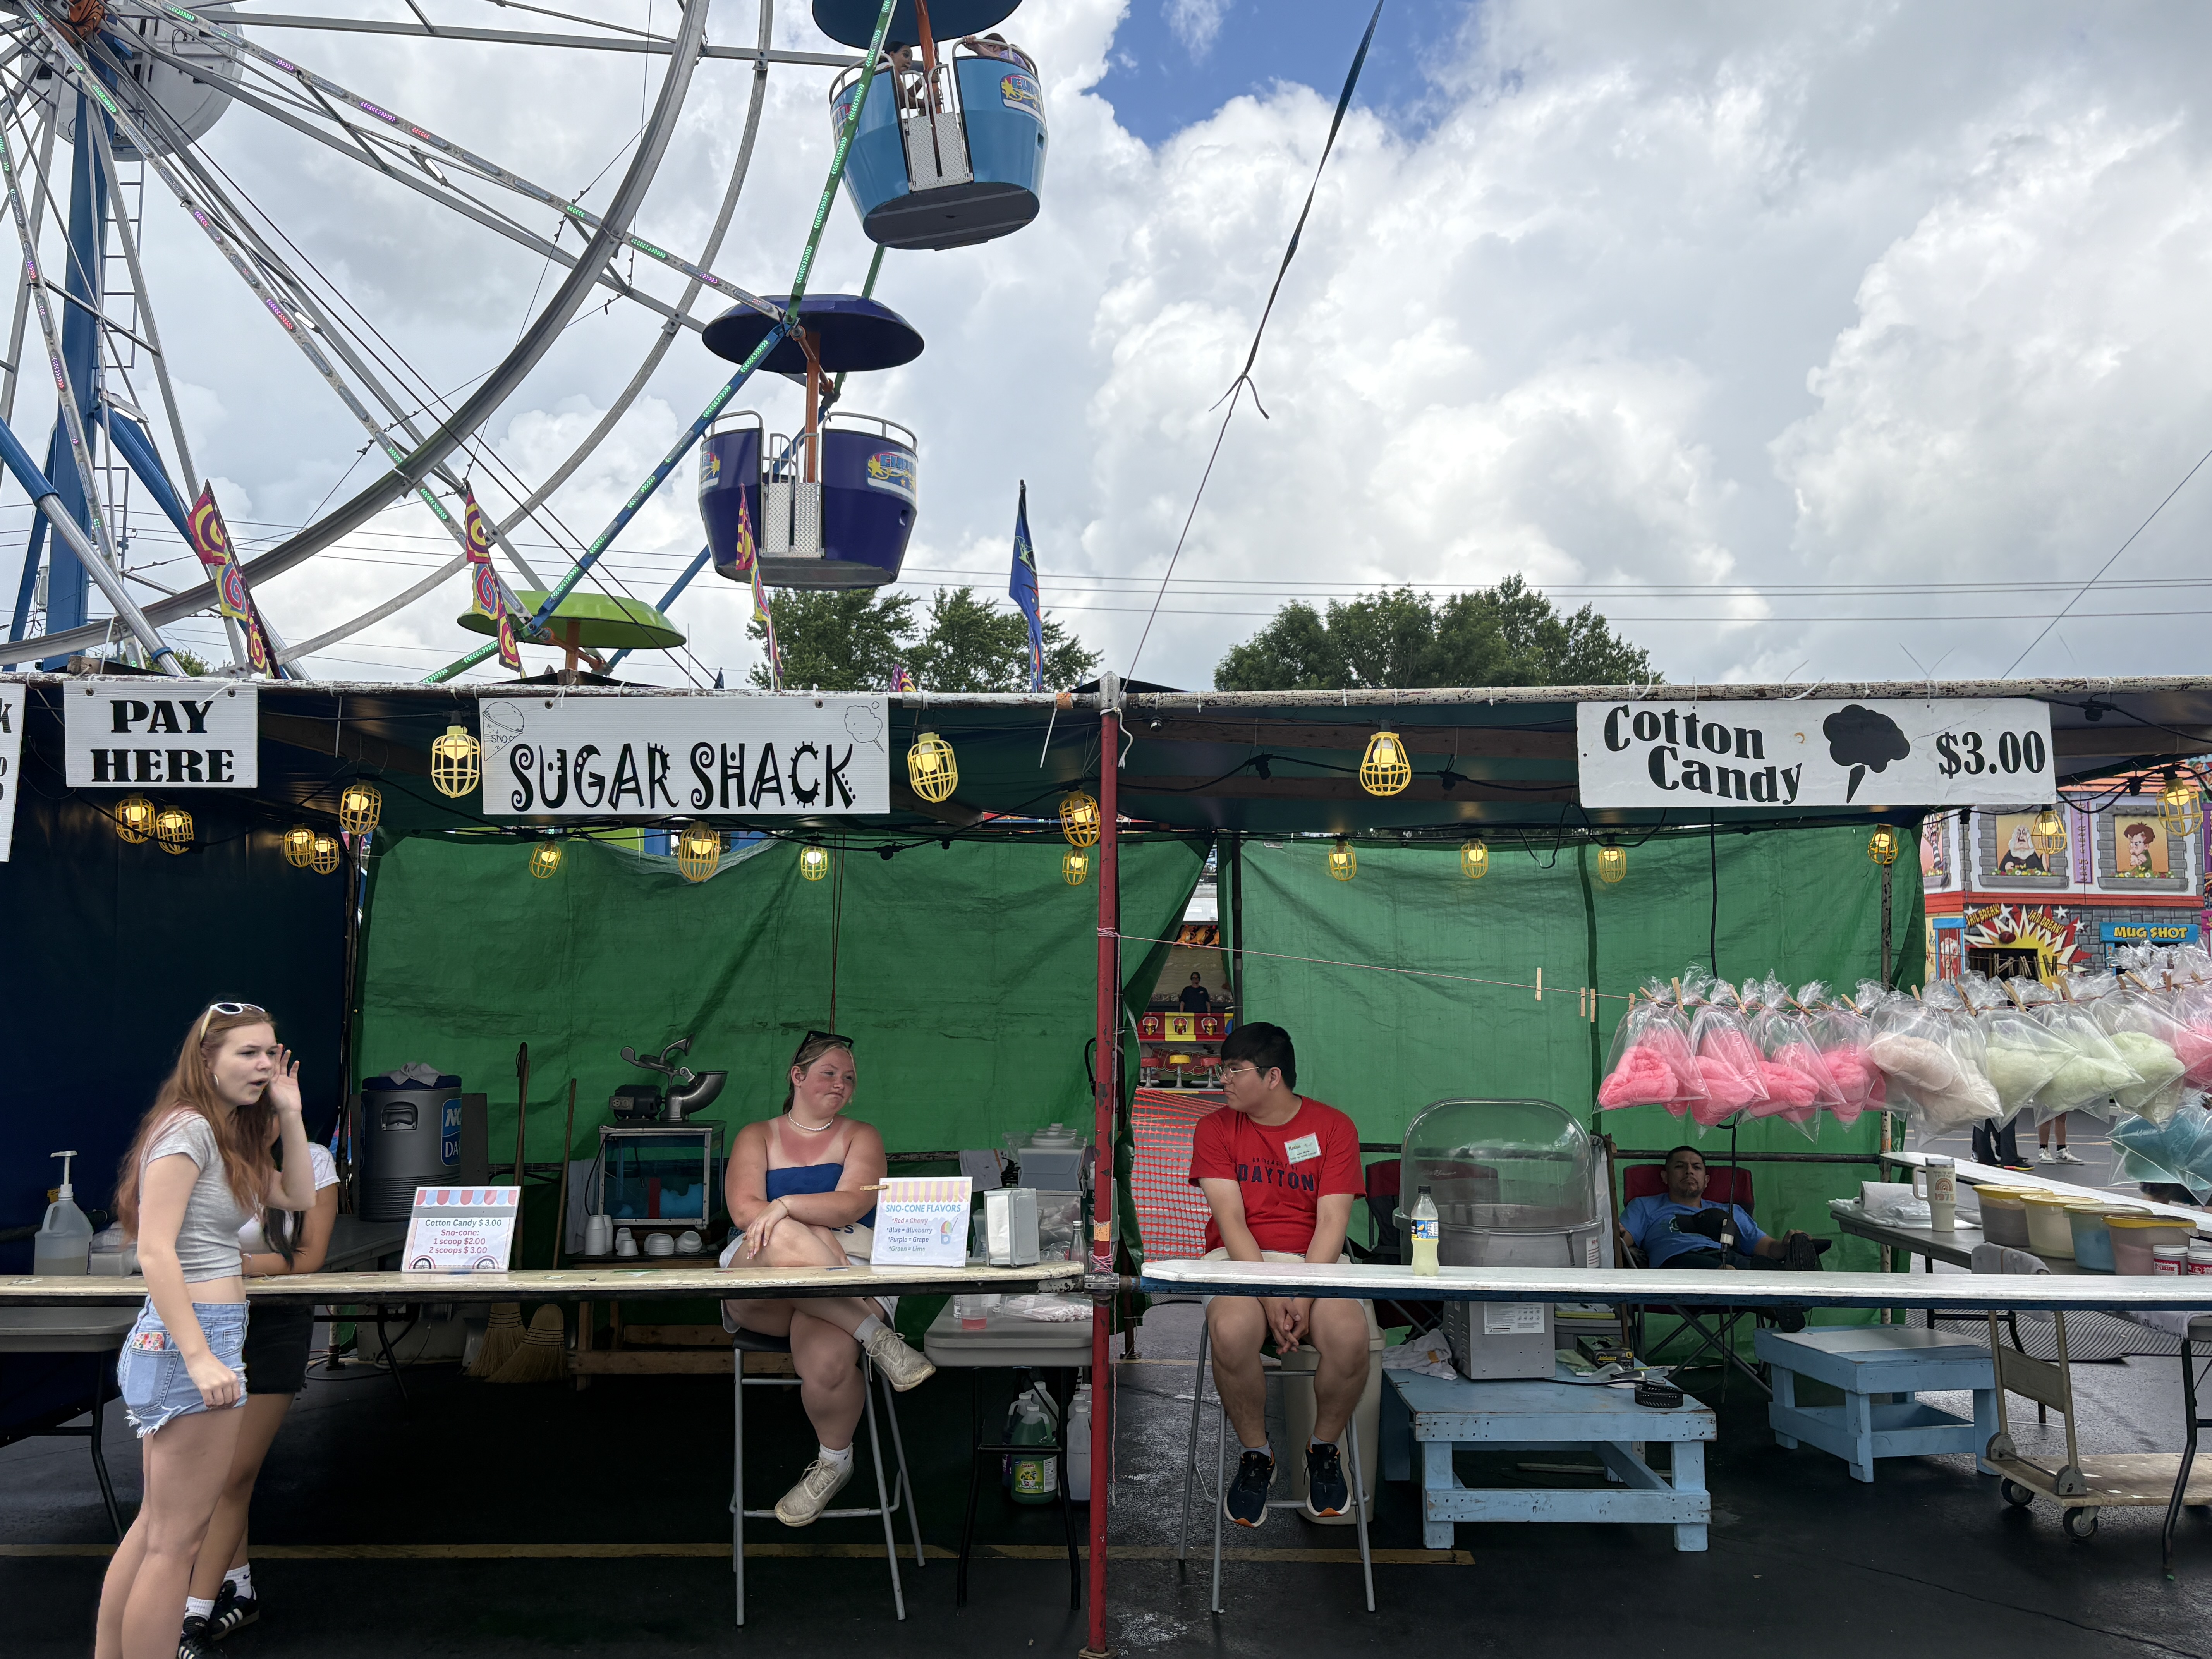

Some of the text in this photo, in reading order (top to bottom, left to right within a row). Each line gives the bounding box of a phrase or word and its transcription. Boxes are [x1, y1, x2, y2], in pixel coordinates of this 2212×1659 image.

[110, 700, 213, 733] PAY
[1604, 704, 1765, 760] Cotton
[90, 749, 234, 783] HERE
[1936, 730, 2045, 779] $3.00
[510, 740, 856, 812] SUGAR SHACK
[1647, 745, 1803, 805] Candy
[1965, 903, 2001, 927] JAIL BREAK!
[2027, 909, 2065, 935] JAIL BREAK!
[2114, 926, 2188, 939] MUG SHOT
[1238, 1164, 1314, 1192] DAYTON
[453, 1219, 477, 1228] Candy
